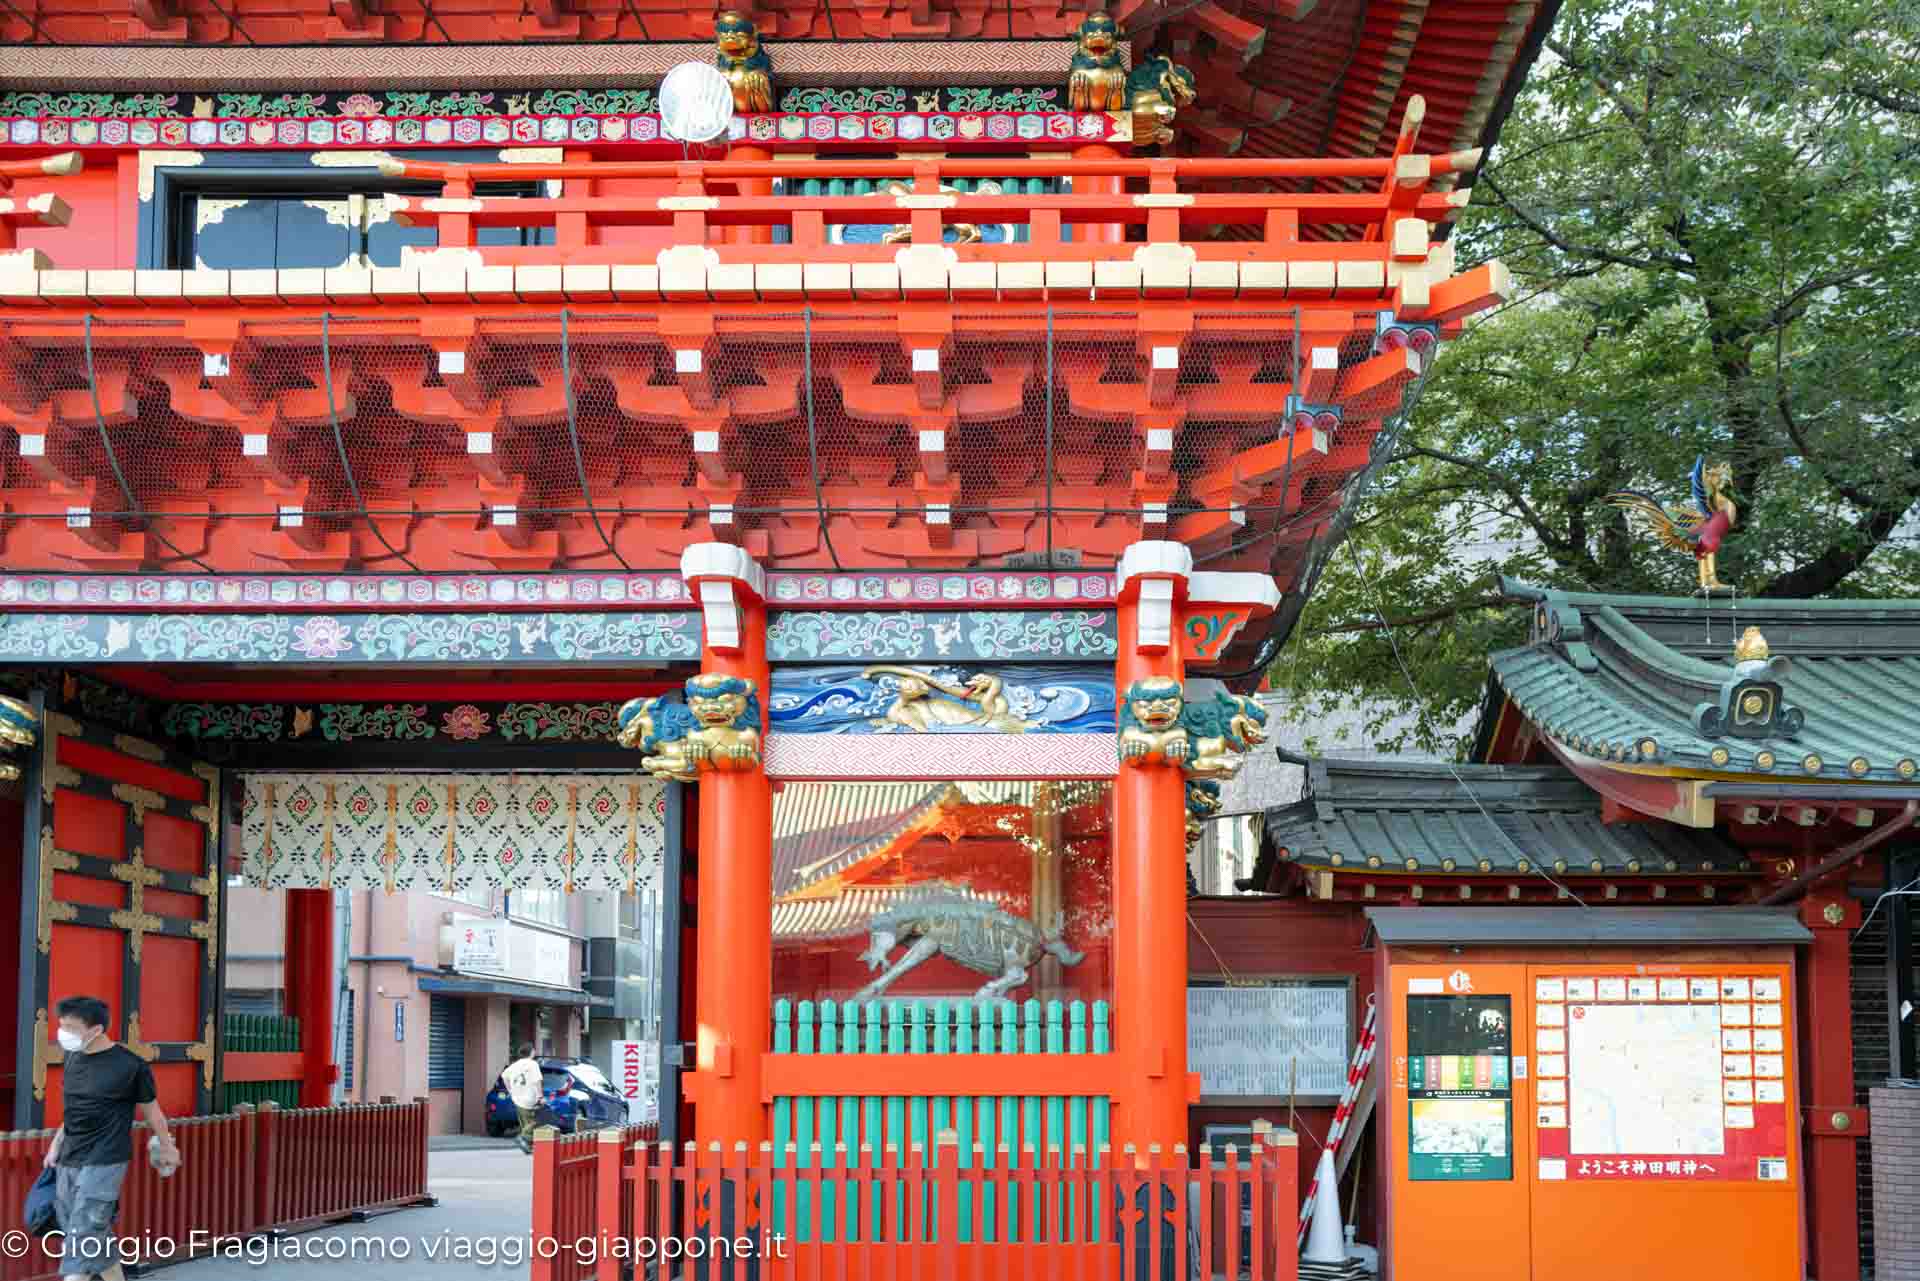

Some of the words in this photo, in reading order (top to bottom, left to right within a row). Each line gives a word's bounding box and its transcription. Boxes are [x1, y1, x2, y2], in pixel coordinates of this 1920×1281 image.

[624, 1044, 639, 1098] KIRIN
[1578, 1159, 1717, 1175] ようこそ神田明神へ
